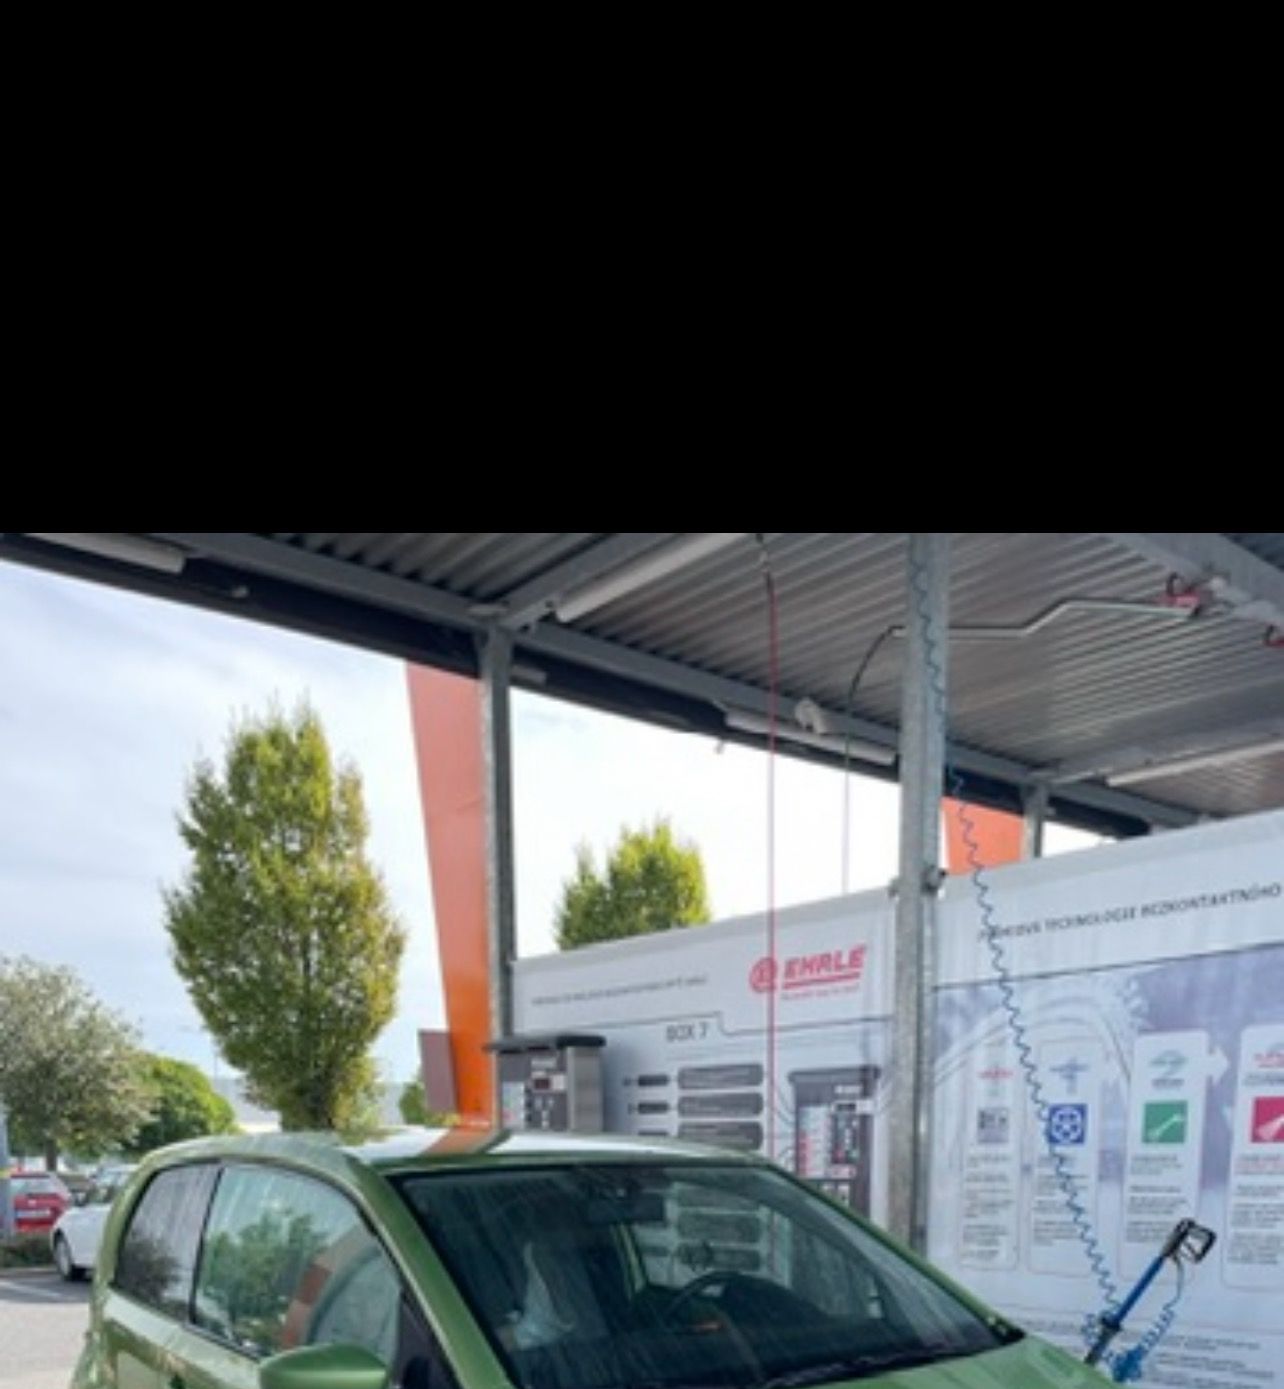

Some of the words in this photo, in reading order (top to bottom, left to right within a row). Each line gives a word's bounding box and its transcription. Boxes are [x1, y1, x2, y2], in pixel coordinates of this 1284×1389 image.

[783, 943, 866, 979] EHRLE
[665, 1023, 695, 1042] BOX
[698, 1020, 707, 1038] 7
